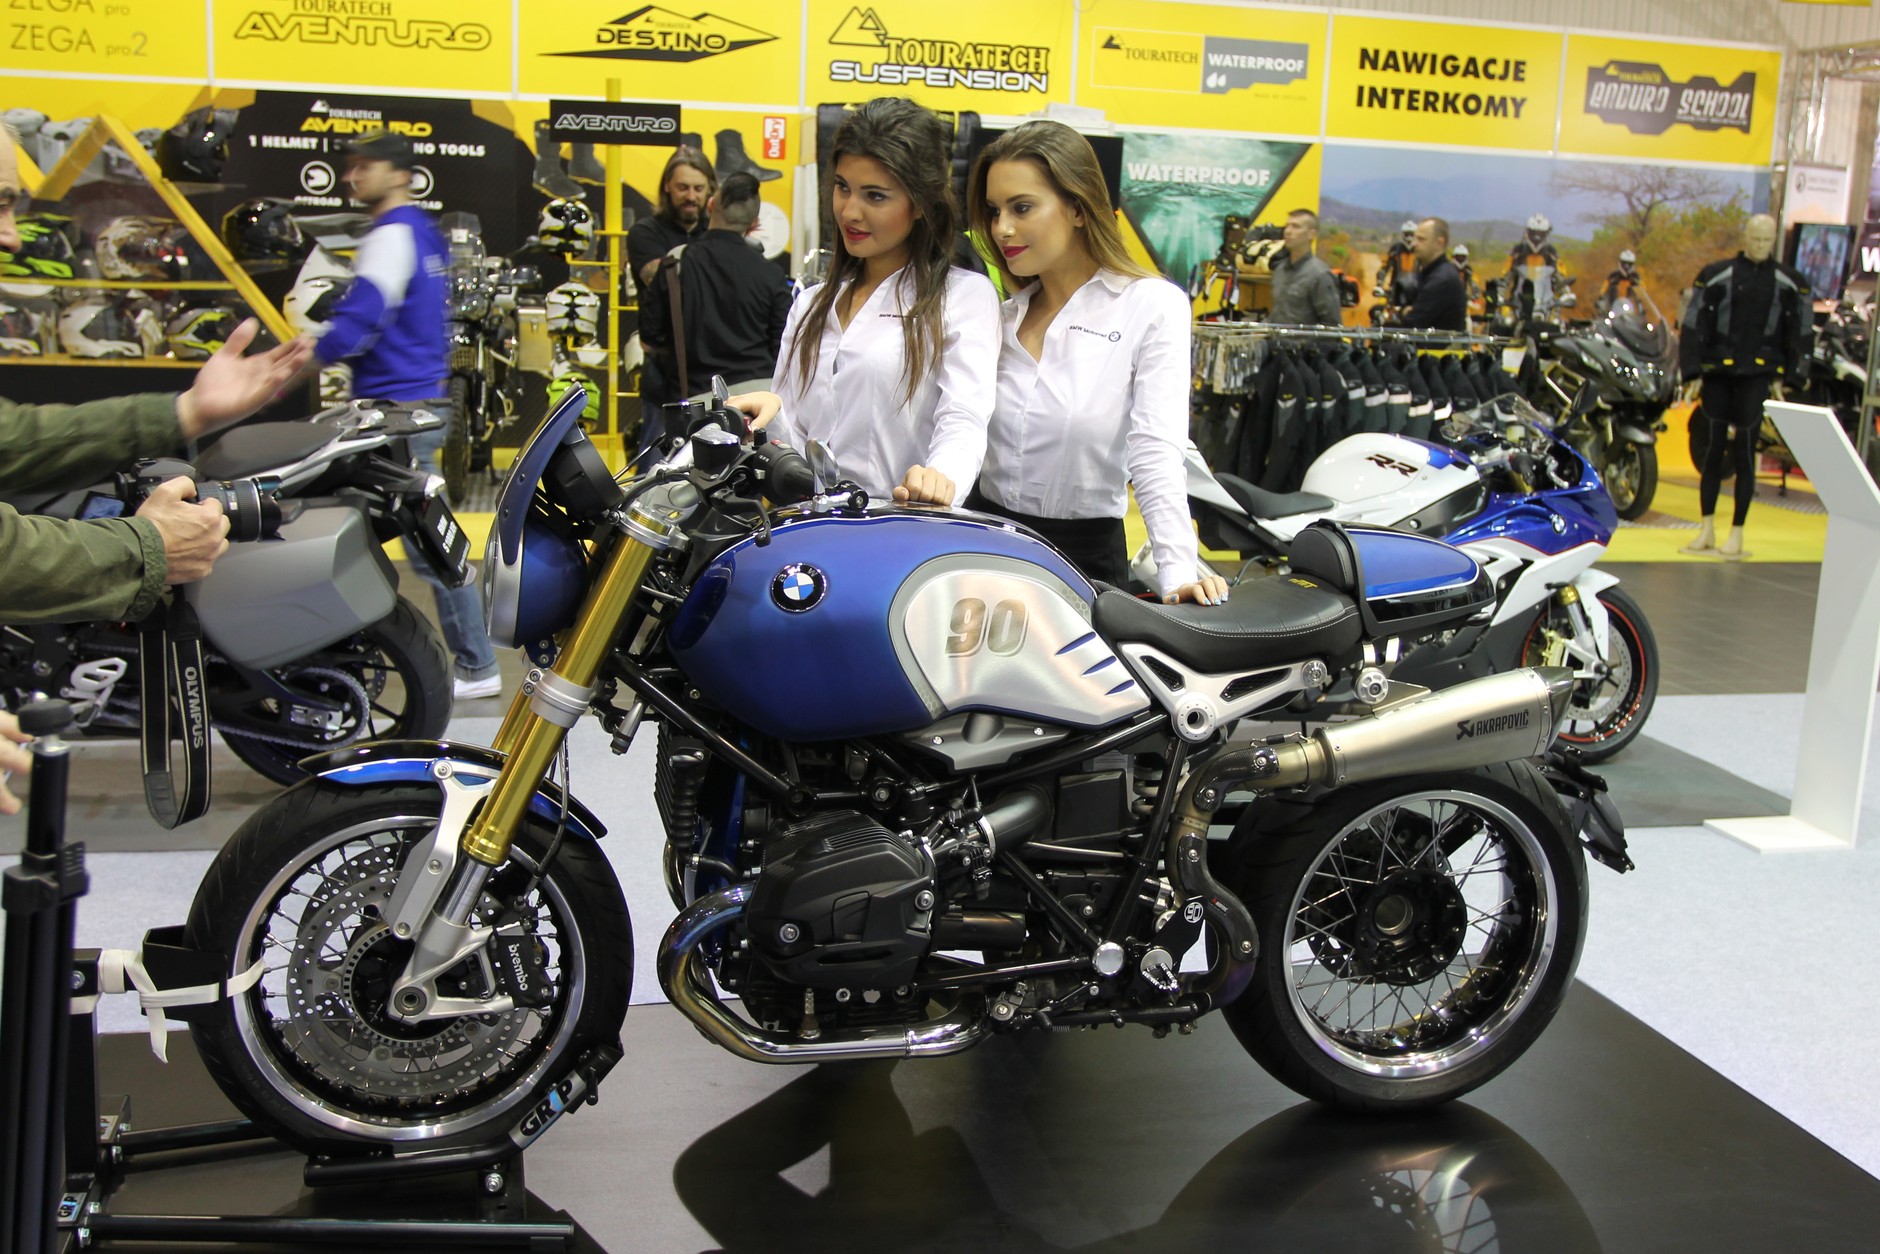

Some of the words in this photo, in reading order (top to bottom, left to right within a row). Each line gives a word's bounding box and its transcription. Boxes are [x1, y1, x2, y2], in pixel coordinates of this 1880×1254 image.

[292, 0, 392, 16] TOURATECH
[10, 23, 97, 53] ZEGA
[234, 11, 491, 51] AVENTURO
[596, 28, 727, 50] DESTINO
[884, 37, 1049, 74] TOURATECH
[1125, 47, 1198, 64] TOURATECH
[1208, 53, 1305, 72] WATERPROOF
[1359, 48, 1526, 82] NAWIGACJE
[829, 60, 1048, 93] SUSPENSION
[1356, 85, 1527, 119] INTERKOMY
[554, 113, 677, 133] AVENTURO
[262, 136, 318, 150] HELMET
[439, 144, 486, 157] TOOLS
[1126, 162, 1270, 187] WATERPROOF
[1365, 453, 1418, 478] RR
[944, 597, 1030, 658] 90
[185, 666, 204, 750] OLYMPUS
[508, 943, 528, 992] brembo
